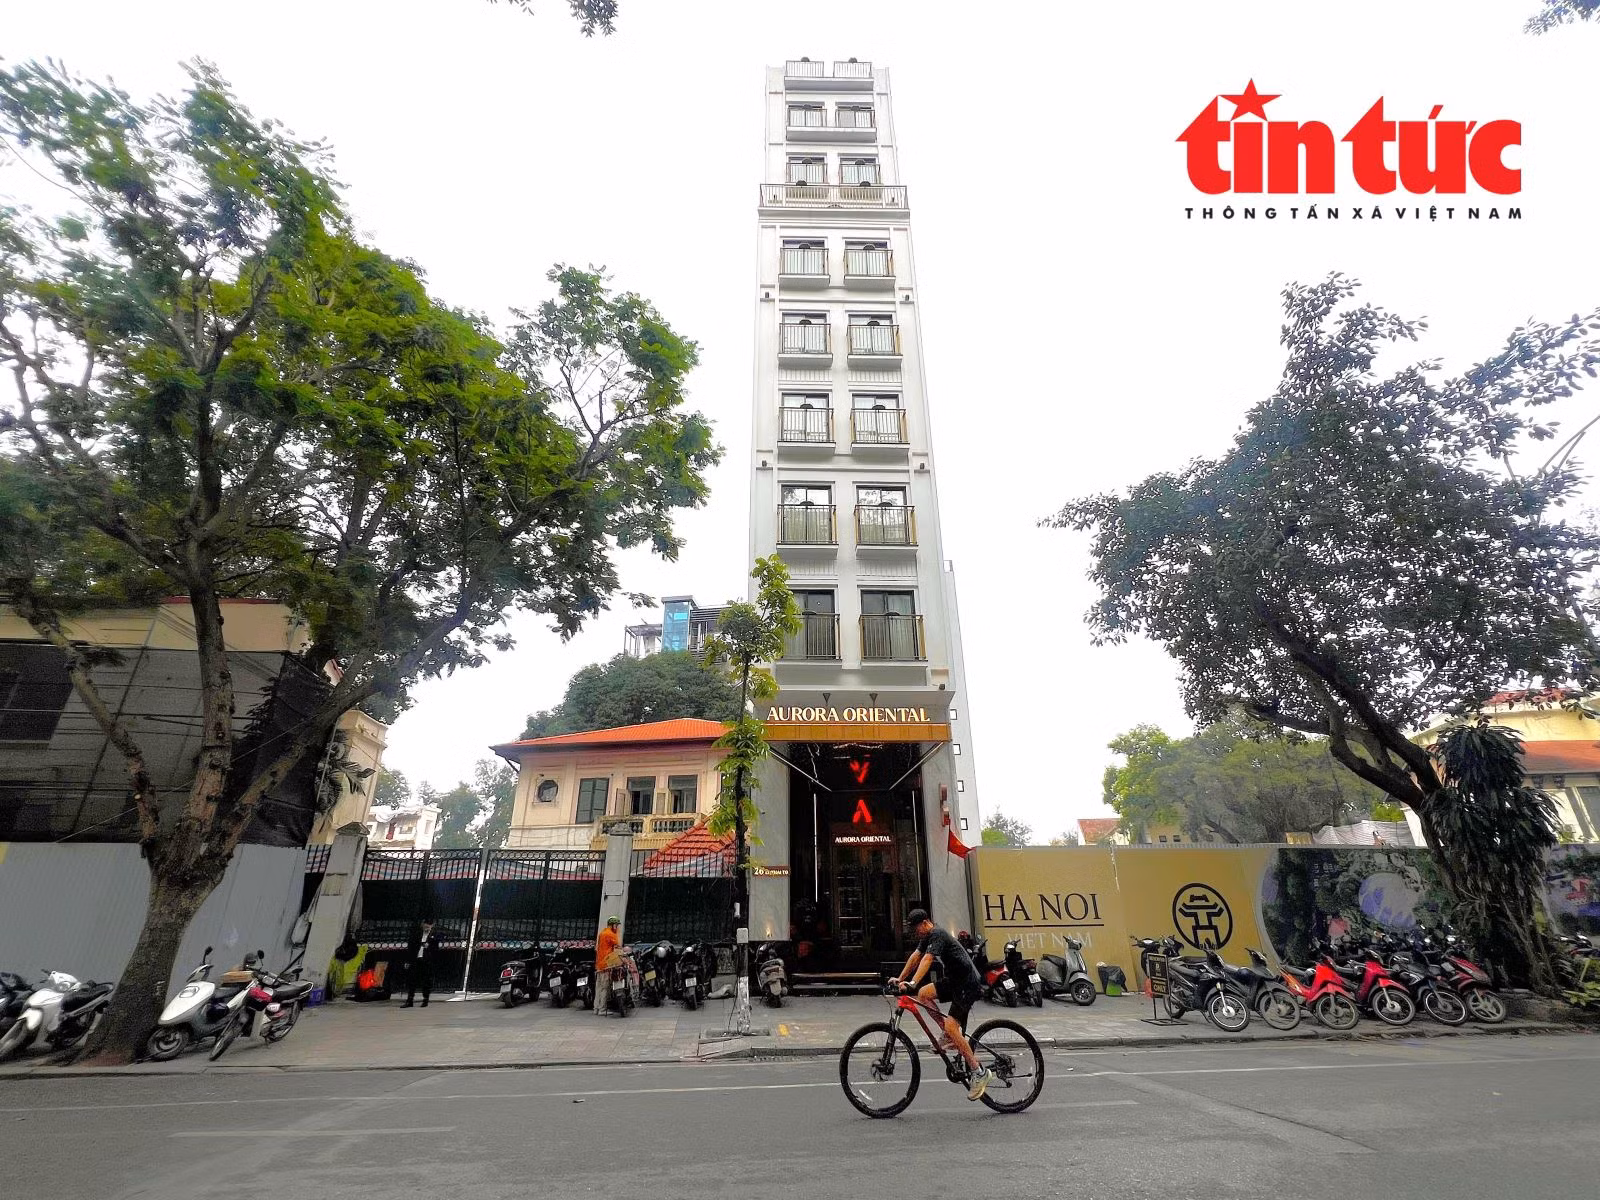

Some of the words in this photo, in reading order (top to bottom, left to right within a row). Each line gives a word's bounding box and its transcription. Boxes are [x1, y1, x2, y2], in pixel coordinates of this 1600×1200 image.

[766, 706, 840, 722] AURORA
[843, 706, 931, 722] ORIENTAL
[754, 867, 764, 875] 26
[982, 894, 1032, 921] HA
[1038, 893, 1102, 920] NOI
[1007, 932, 1048, 949] VIET
[1051, 931, 1094, 948] NM
